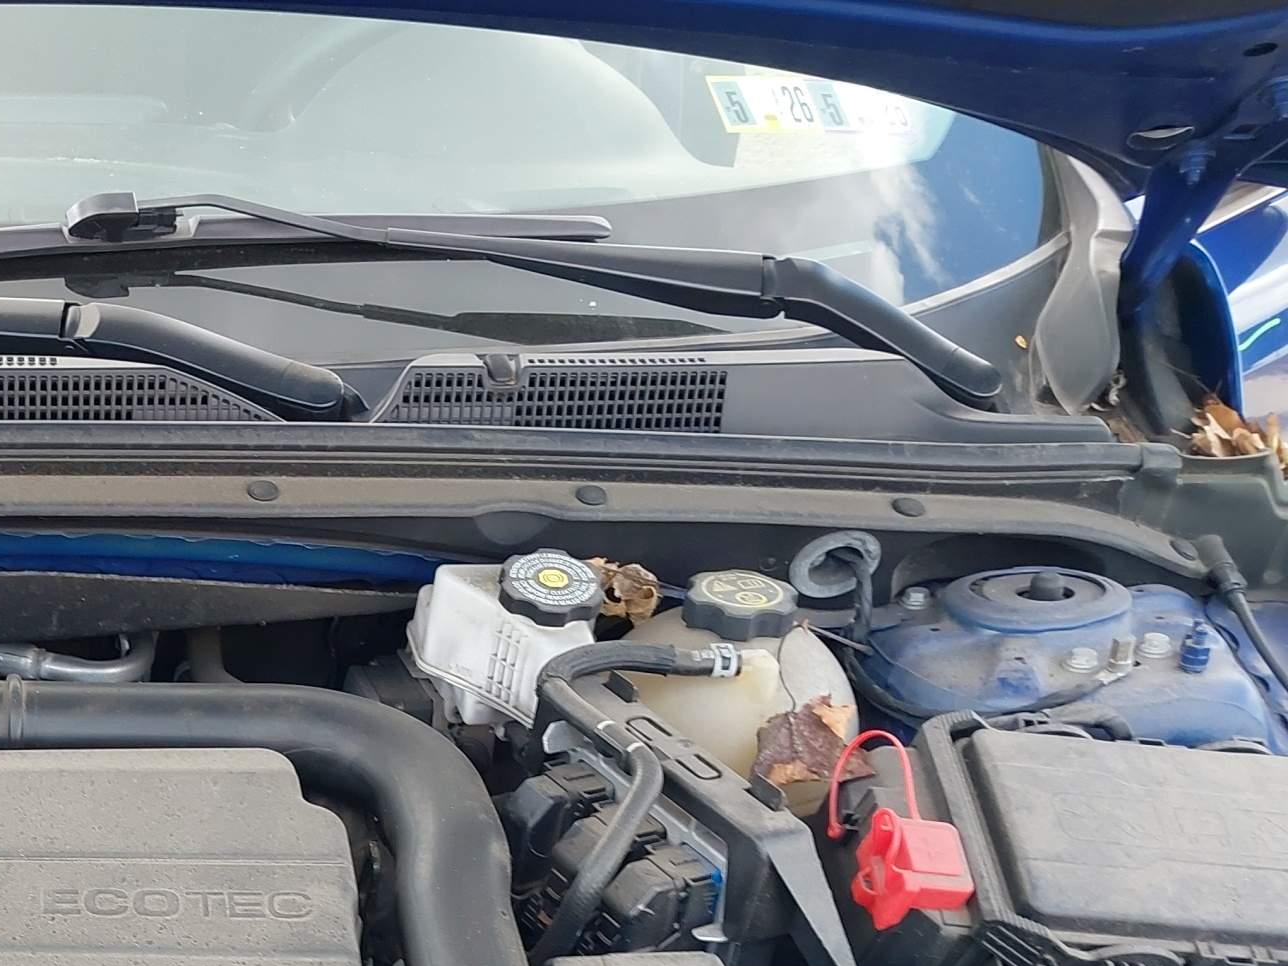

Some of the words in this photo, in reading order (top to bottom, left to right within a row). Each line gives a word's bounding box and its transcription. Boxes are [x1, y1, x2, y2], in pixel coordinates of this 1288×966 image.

[724, 90, 750, 124] 5
[780, 85, 815, 123] 26
[820, 92, 845, 127] 5
[42, 888, 313, 920] ECOTEC
